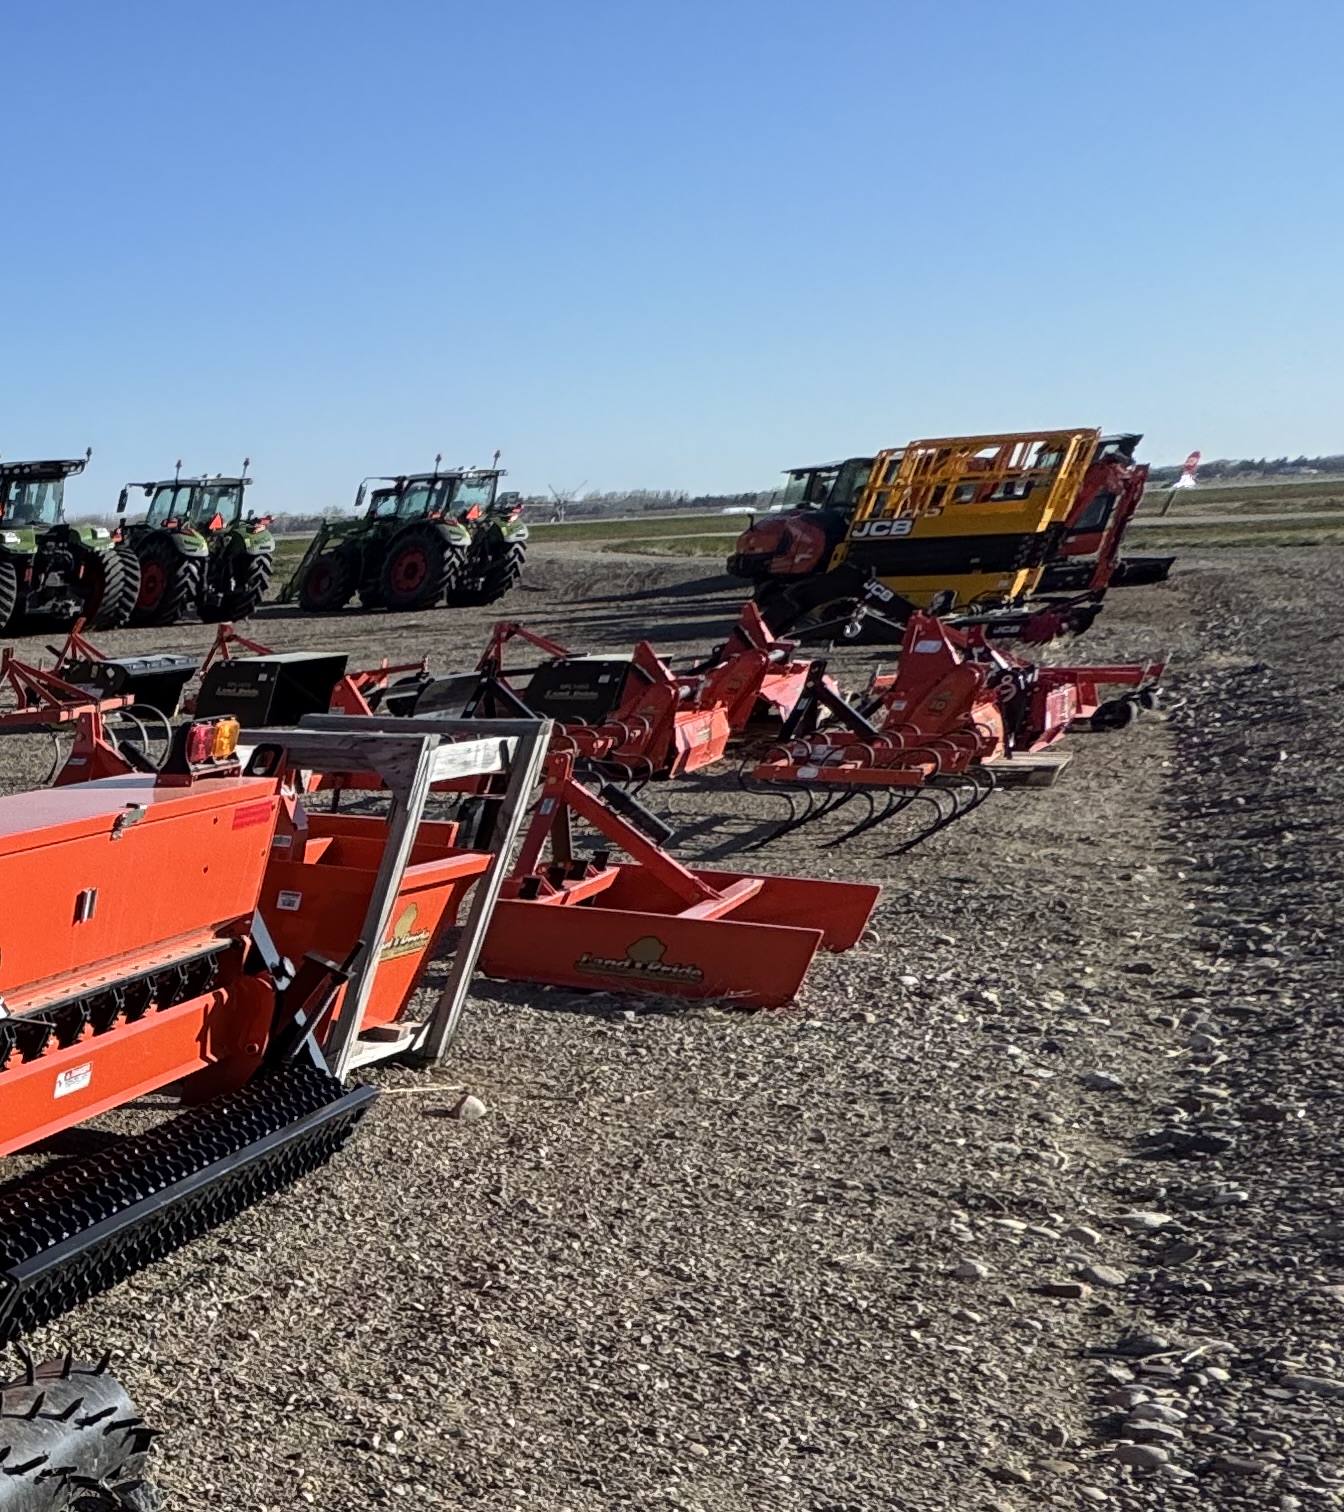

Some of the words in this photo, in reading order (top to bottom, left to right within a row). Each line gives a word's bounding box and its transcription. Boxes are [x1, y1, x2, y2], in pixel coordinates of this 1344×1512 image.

[852, 520, 912, 537] JCB
[863, 579, 894, 602] JCB
[993, 625, 1020, 634] JCB
